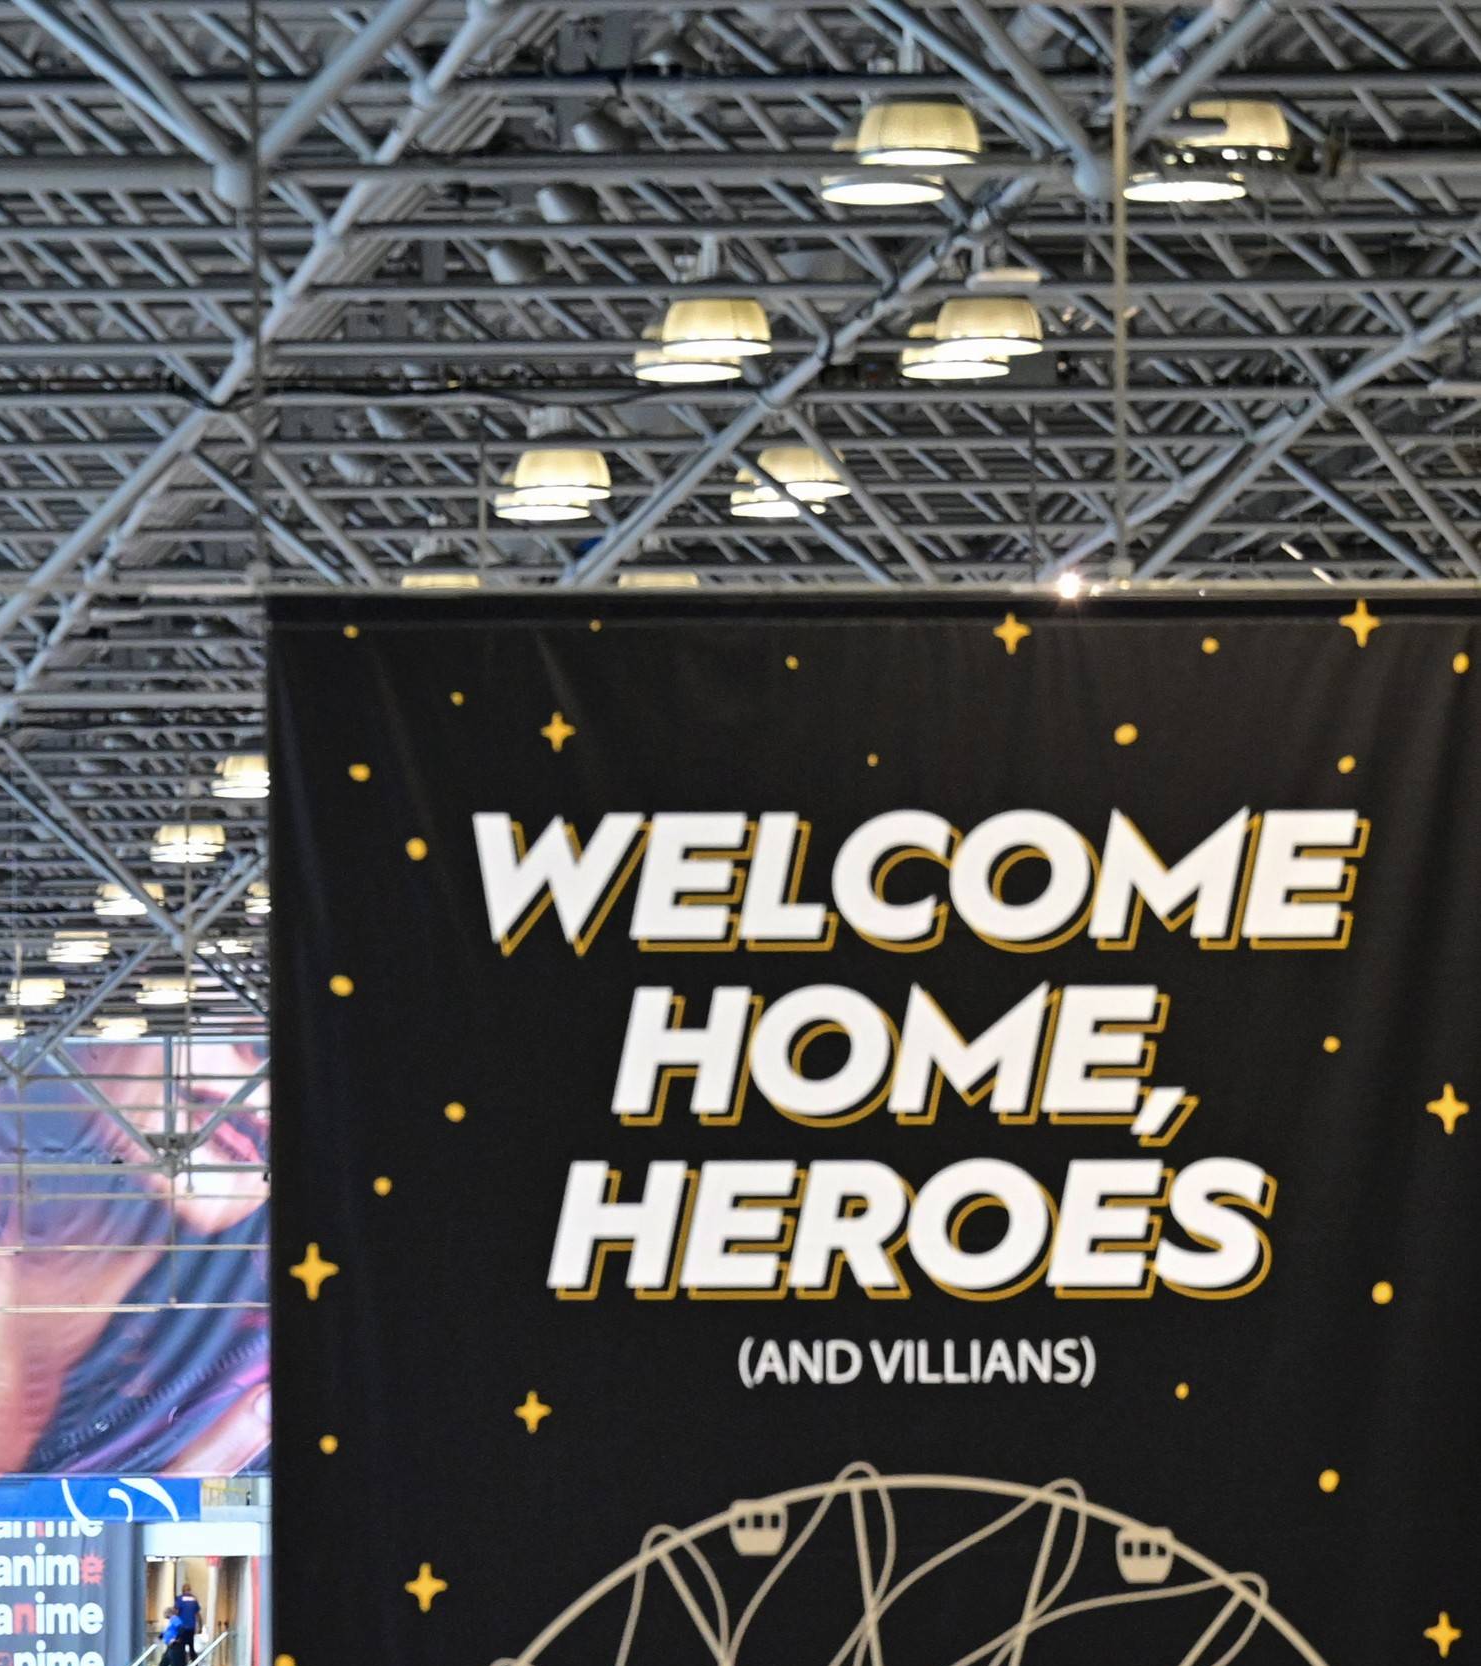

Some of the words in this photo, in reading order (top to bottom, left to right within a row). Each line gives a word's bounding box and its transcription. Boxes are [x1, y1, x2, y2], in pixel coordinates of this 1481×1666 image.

[472, 807, 1369, 956] WELCOME
[611, 980, 1199, 1145] HOME,
[546, 1157, 1277, 1300] HEROES
[738, 1336, 863, 1389] (AND
[869, 1336, 1097, 1389] VILLIANS)
